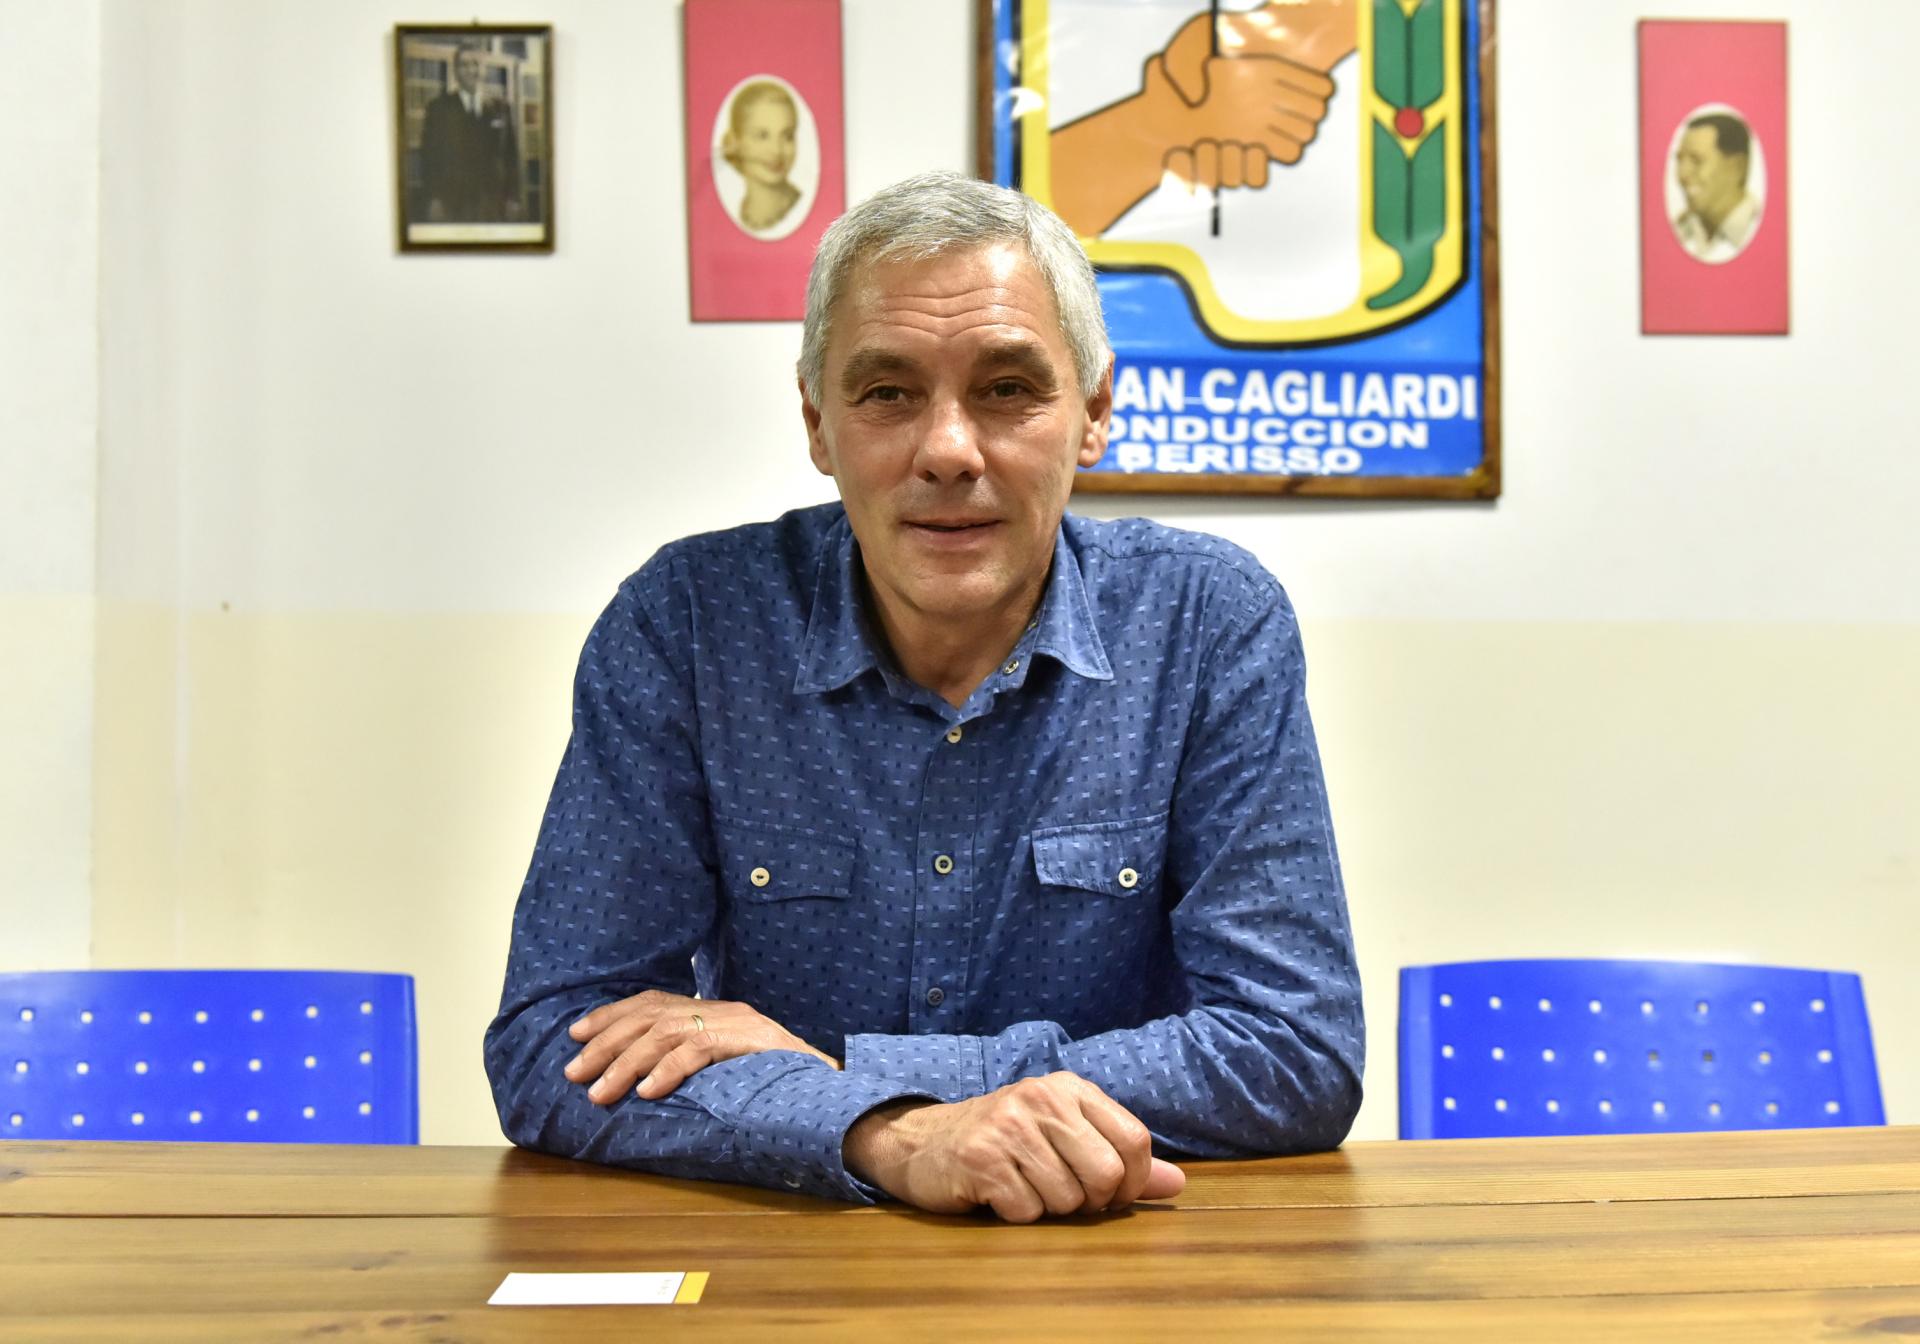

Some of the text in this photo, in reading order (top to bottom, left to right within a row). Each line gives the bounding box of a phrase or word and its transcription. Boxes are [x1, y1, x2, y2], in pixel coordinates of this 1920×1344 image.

[1113, 366, 1477, 419] AN CAGLIARDI
[1116, 442, 1362, 473] BERISSO
